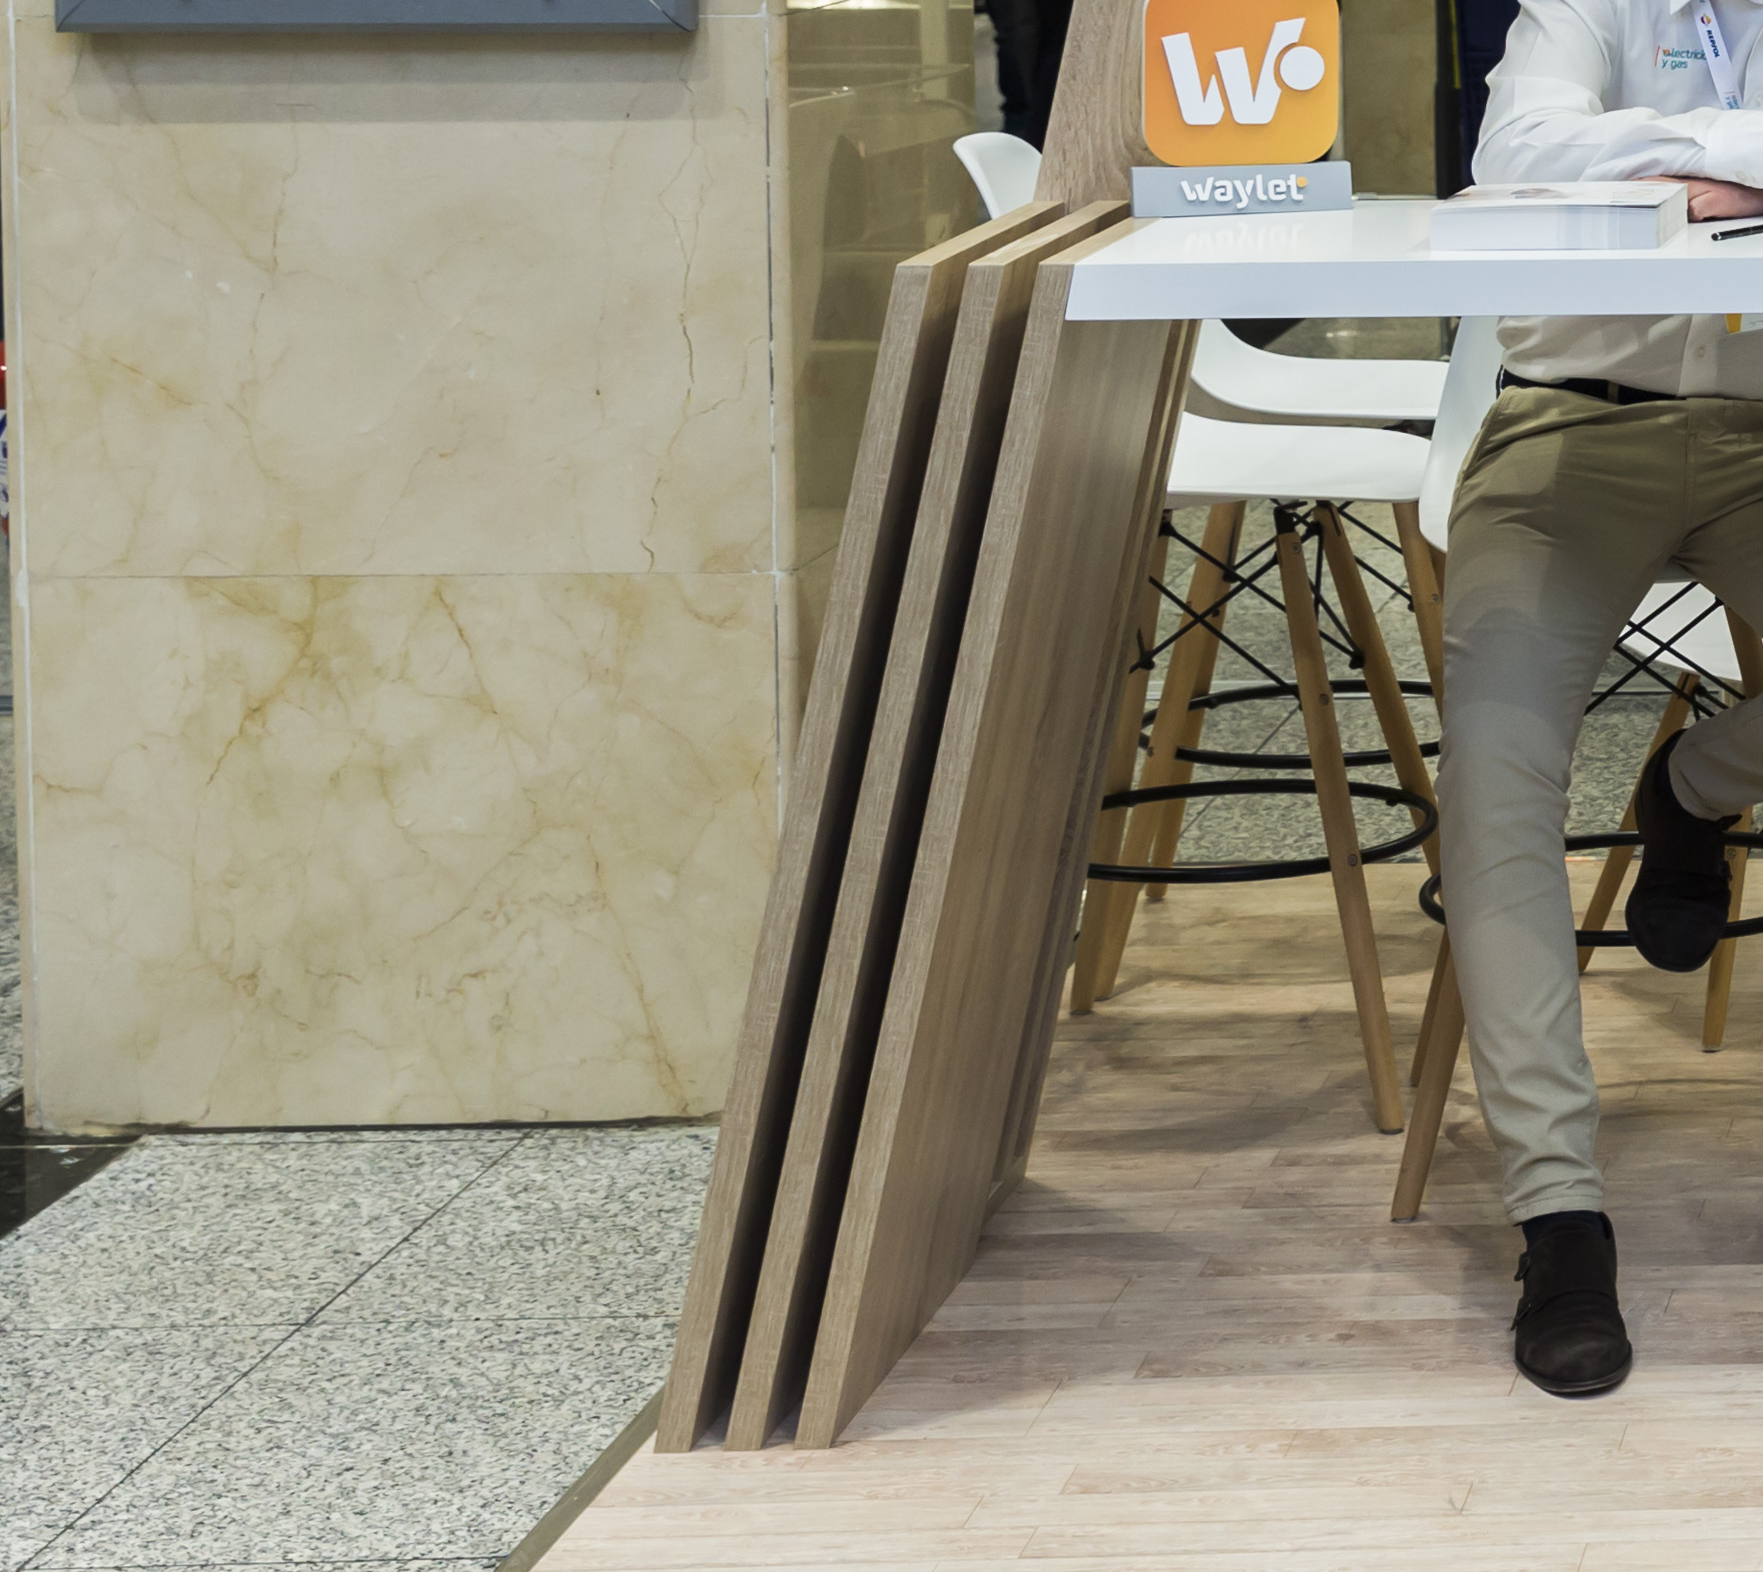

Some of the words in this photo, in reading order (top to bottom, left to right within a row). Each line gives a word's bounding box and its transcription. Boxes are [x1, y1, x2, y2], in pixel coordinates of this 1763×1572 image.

[1662, 59, 1669, 69] y
[1671, 60, 1688, 70] gas
[1180, 174, 1306, 209] waylet
